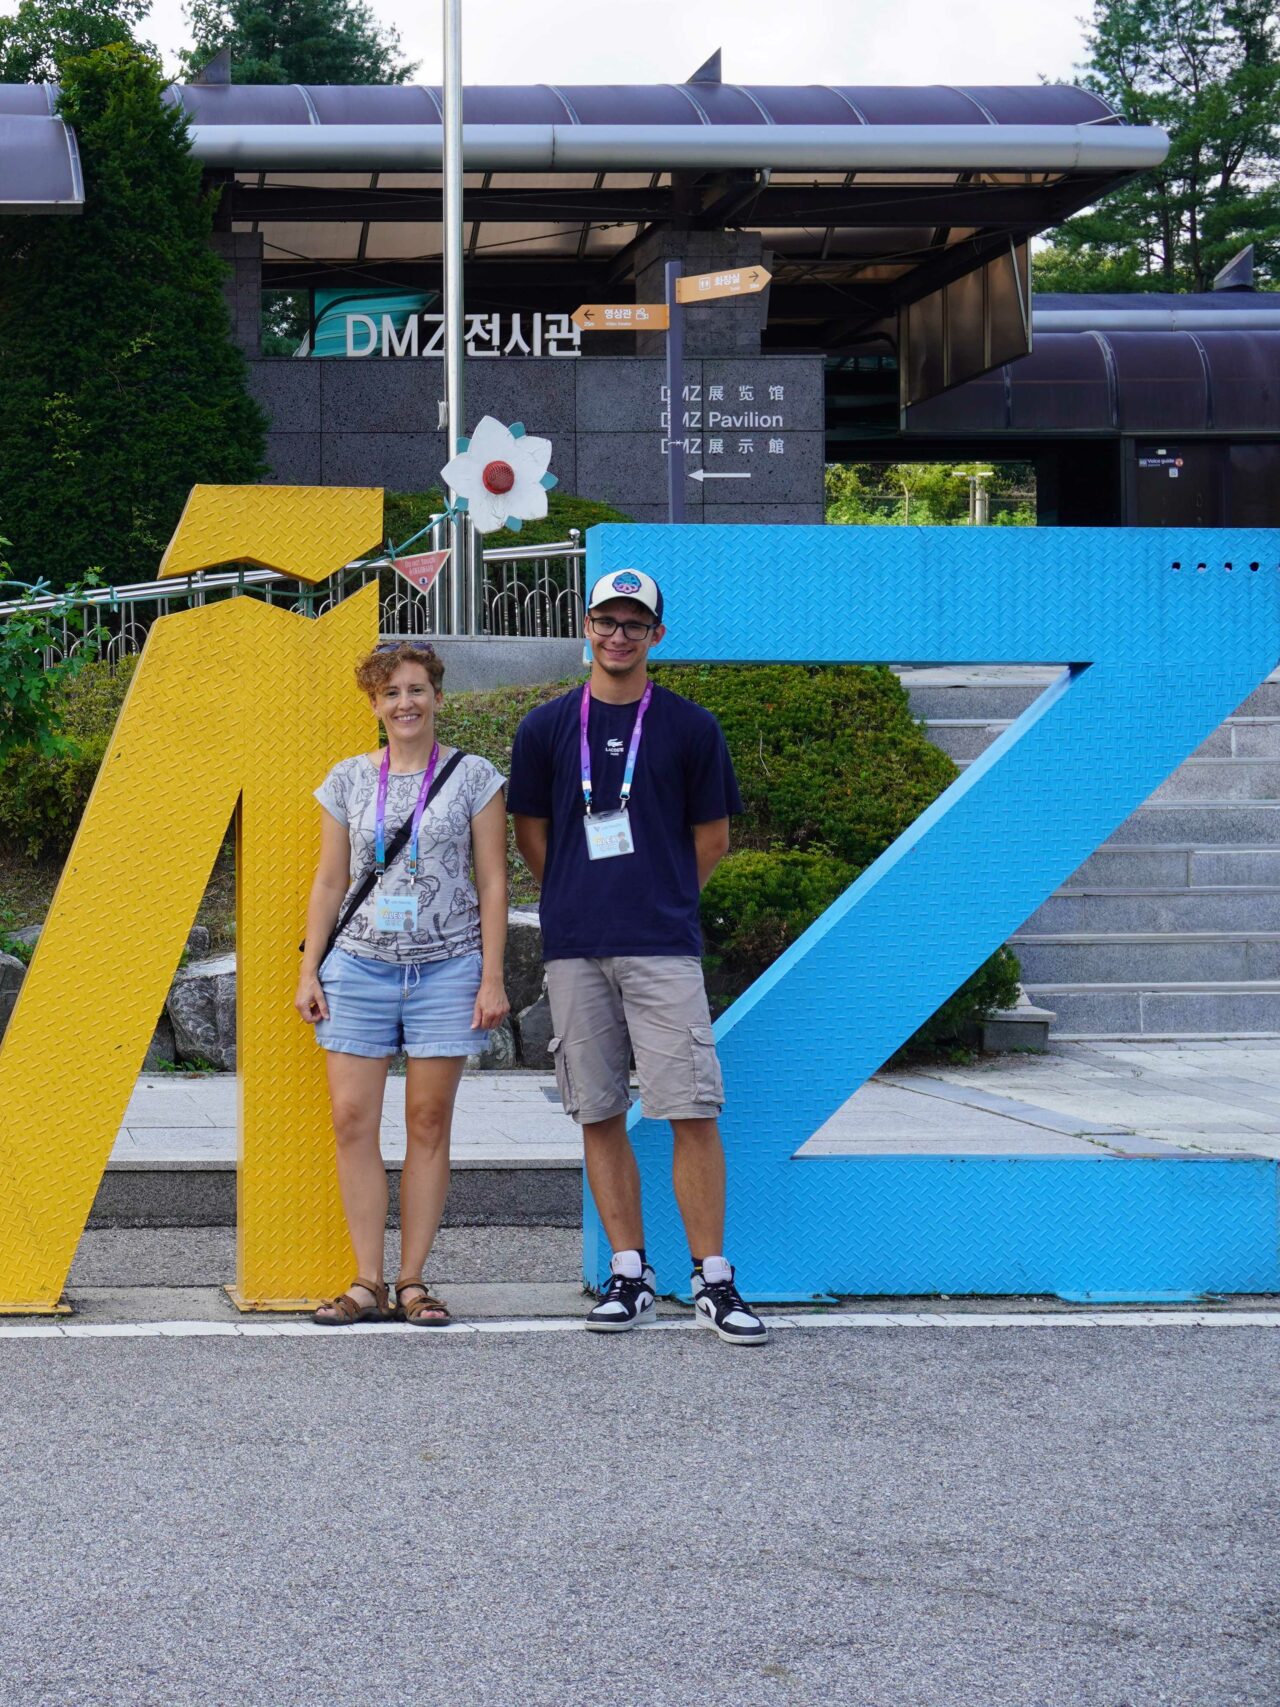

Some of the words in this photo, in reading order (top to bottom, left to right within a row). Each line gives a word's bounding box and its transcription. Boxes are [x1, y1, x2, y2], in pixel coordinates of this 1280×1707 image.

[715, 273, 740, 286] 화장실
[604, 307, 632, 319] 영상관
[709, 411, 783, 428] Pavilion
